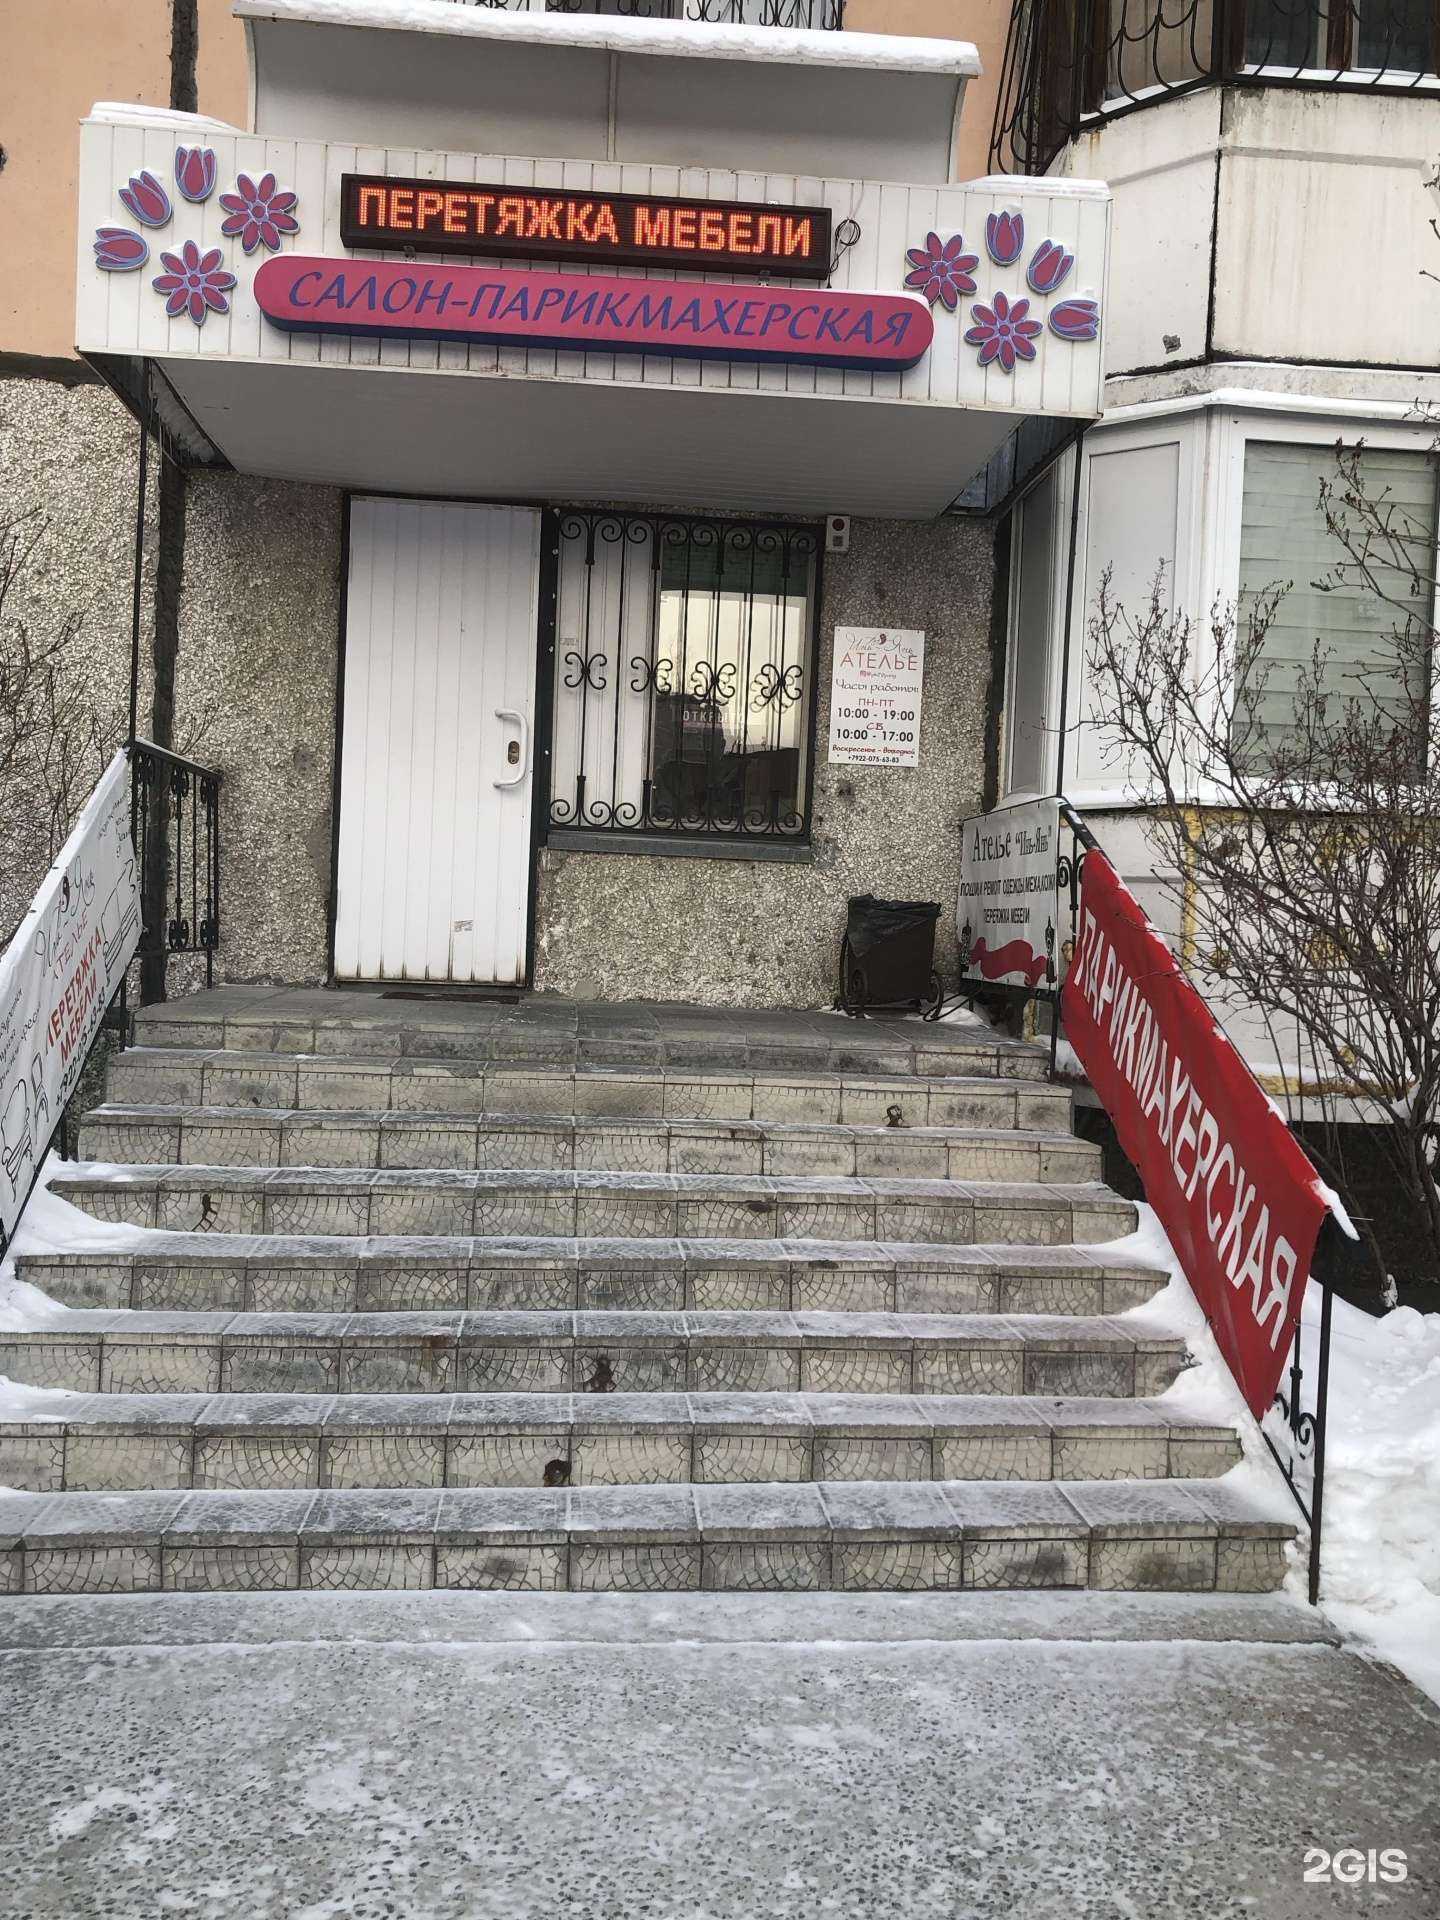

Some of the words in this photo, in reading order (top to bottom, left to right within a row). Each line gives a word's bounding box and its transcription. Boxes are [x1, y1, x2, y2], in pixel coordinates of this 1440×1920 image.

[358, 185, 618, 244] ПЕРЕТЯЖКА
[633, 207, 811, 257] МЕБЕЛИ
[289, 271, 912, 347] САЛОН-ПАРИКМАХЕРСКАЯ
[839, 651, 918, 671] АТЕЛЬЕ
[836, 678, 868, 690] Часы
[858, 698, 895, 707] ПН-ПТ
[837, 708, 869, 719] 10:00
[883, 710, 915, 721] 19:00
[836, 728, 868, 740] 10:00
[882, 731, 914, 742] 17:00
[866, 722, 884, 731] СБ
[972, 826, 1011, 862] Ателье
[60, 968, 97, 1069] МЕБЕЛИ
[1073, 906, 1298, 1350] ПАРИКМАХЕРСКАЯ
